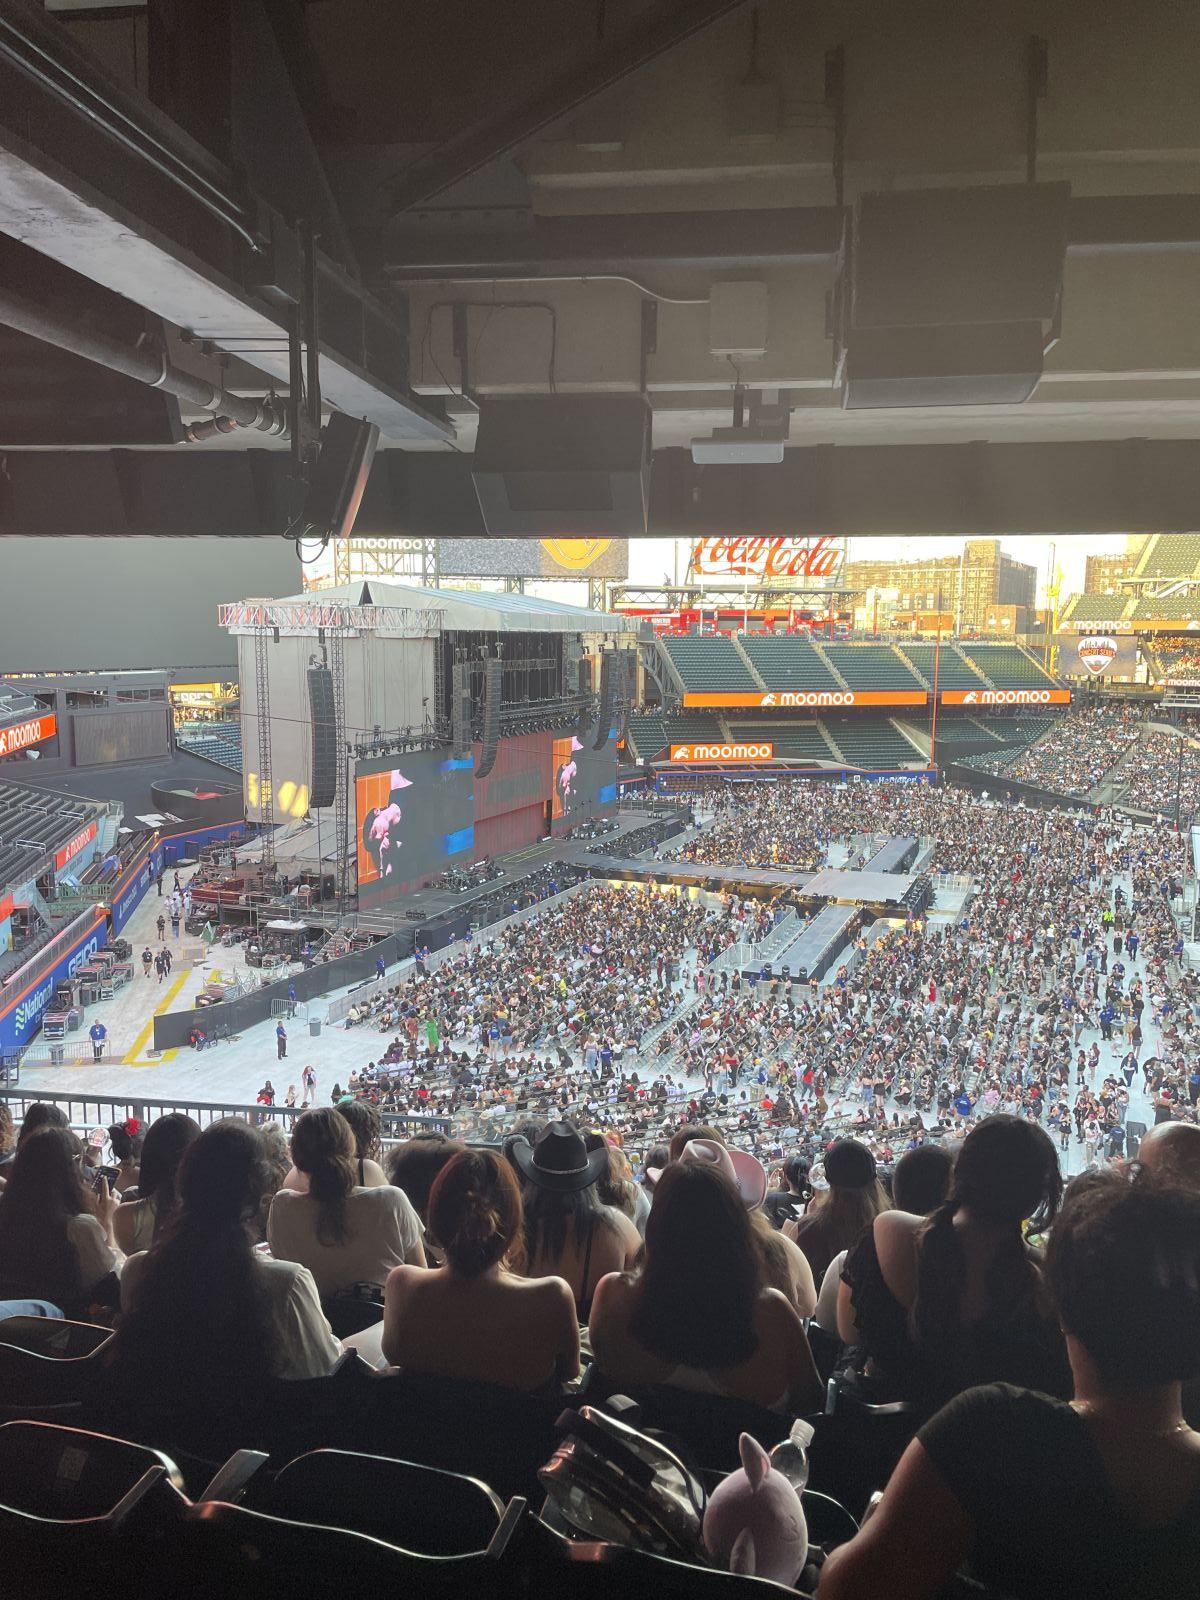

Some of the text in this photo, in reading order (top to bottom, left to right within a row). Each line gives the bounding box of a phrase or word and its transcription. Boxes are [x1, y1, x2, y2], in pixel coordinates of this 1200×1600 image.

[351, 538, 423, 549] moomoo
[1074, 621, 1132, 630] moomoo
[780, 692, 855, 705] moomoo
[981, 691, 1051, 703] moomoo
[8, 721, 41, 750] moomoo
[693, 745, 771, 759] moomoo
[68, 936, 97, 978] GEICO
[23, 977, 54, 1024] National
